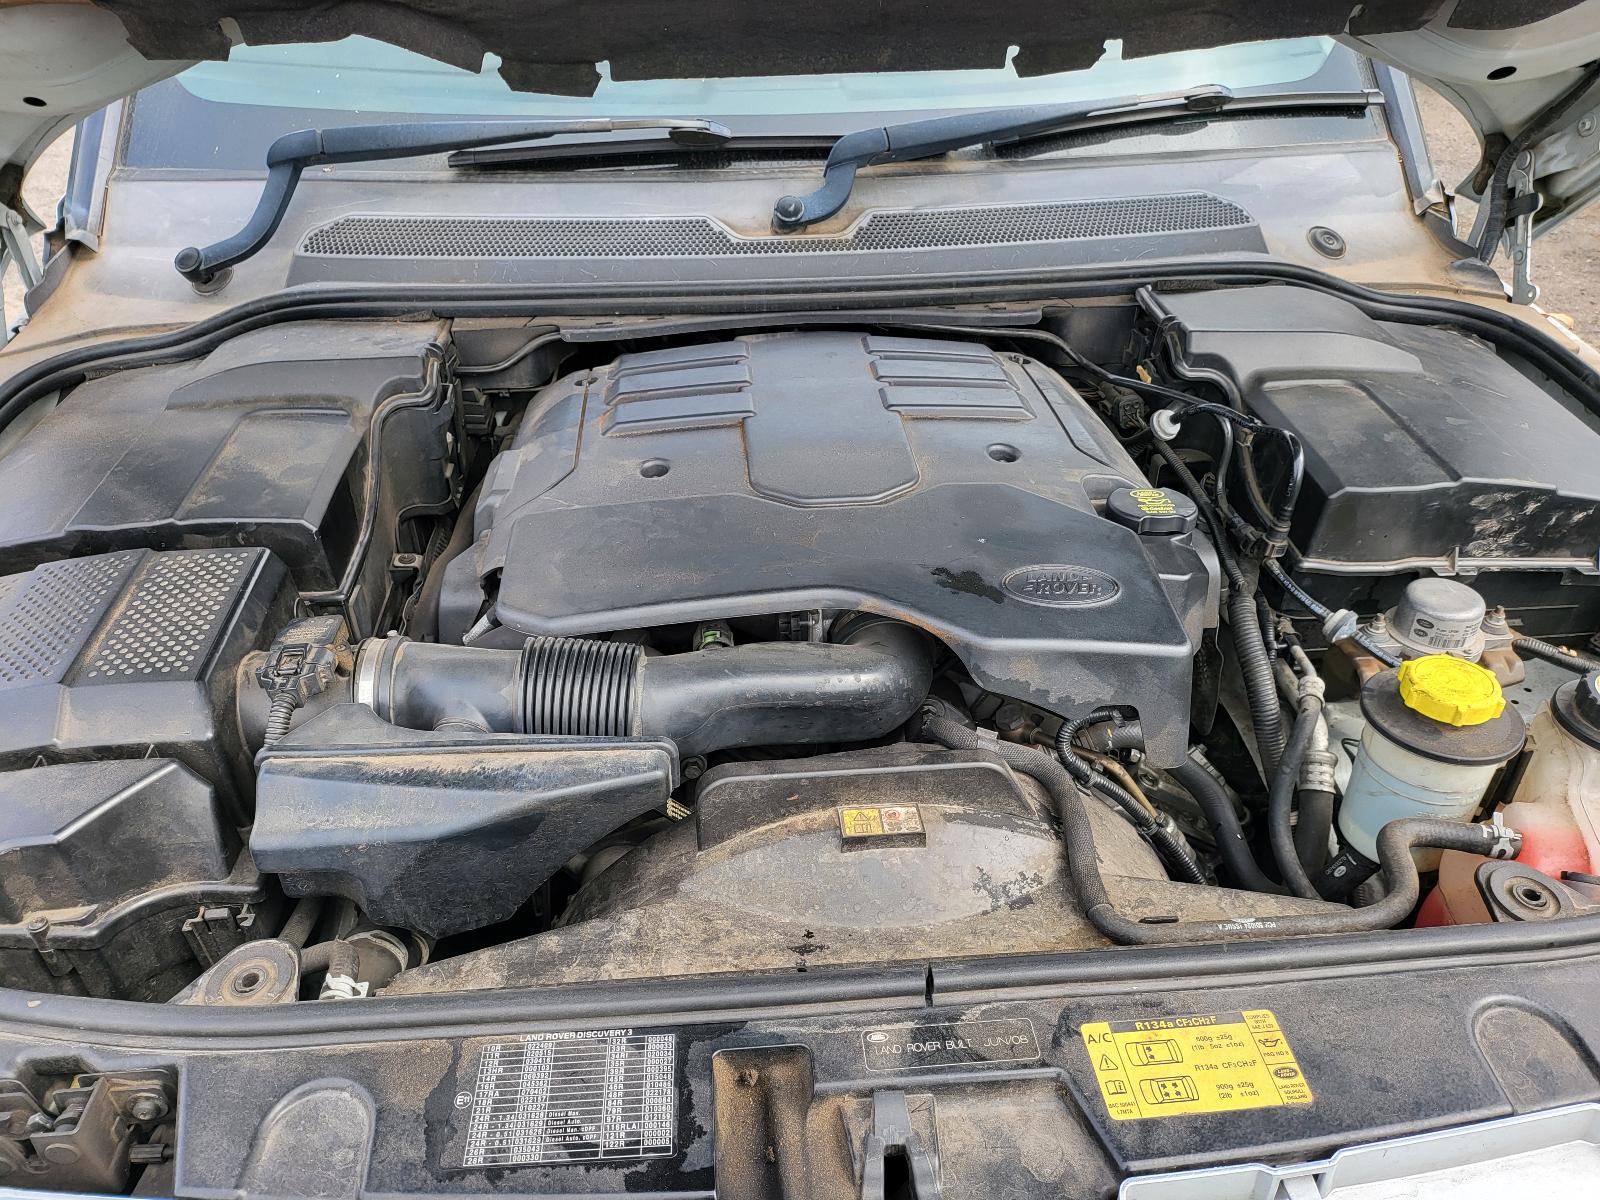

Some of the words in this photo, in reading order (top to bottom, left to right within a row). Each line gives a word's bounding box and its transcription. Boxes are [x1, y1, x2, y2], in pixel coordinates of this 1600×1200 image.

[1026, 572, 1079, 582] LAND
[1036, 583, 1101, 595] ROVER
[1135, 1020, 1174, 1031] R134a
[520, 1033, 544, 1042] LAND
[545, 1032, 576, 1040] ROVER
[577, 1030, 627, 1039] DISCOVERY
[1087, 1032, 1112, 1044] A/C
[875, 1045, 902, 1055] LAND
[907, 1042, 941, 1053] ROVER
[945, 1039, 972, 1050] BUILT
[983, 1035, 1029, 1047] JUN/08
[1194, 1063, 1219, 1071] R134a
[475, 1106, 491, 1114] 21R
[474, 1114, 490, 1122] 24R
[473, 1123, 489, 1131] 24R
[472, 1131, 488, 1139] 24R
[605, 1131, 625, 1139] 121R
[643, 1129, 670, 1137] 000002
[470, 1139, 486, 1147] 24R
[604, 1140, 625, 1148] 122R
